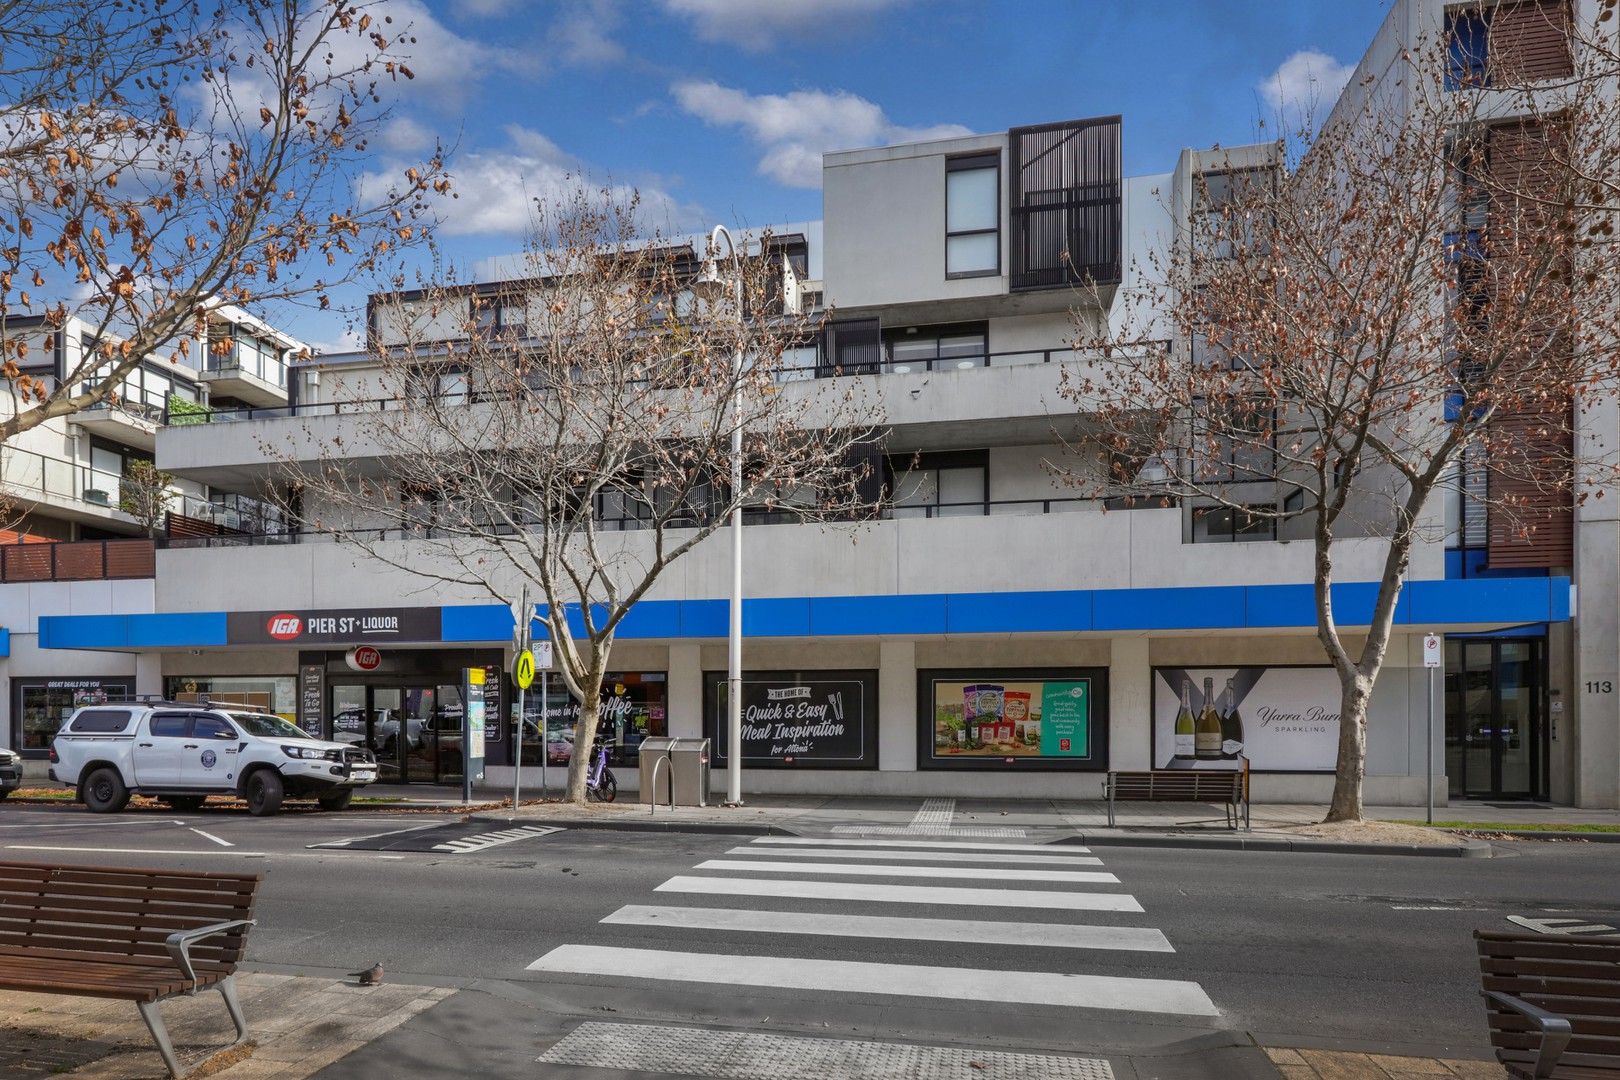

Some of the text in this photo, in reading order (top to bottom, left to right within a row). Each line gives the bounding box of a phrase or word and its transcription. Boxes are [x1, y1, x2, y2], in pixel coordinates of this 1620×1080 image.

[271, 619, 299, 634] IGA
[308, 618, 336, 634] PIER
[339, 617, 355, 633] ST
[362, 616, 398, 629] LIQUOR
[359, 651, 377, 665] IGA
[774, 690, 783, 698] THE
[784, 689, 797, 697] HOME
[1585, 681, 1612, 694] 113
[304, 691, 320, 699] Fresh
[746, 702, 828, 723] Quick & Easy
[1256, 706, 1301, 728] Yarra
[740, 719, 844, 742] Meal Inspiration
[770, 745, 783, 756] for
